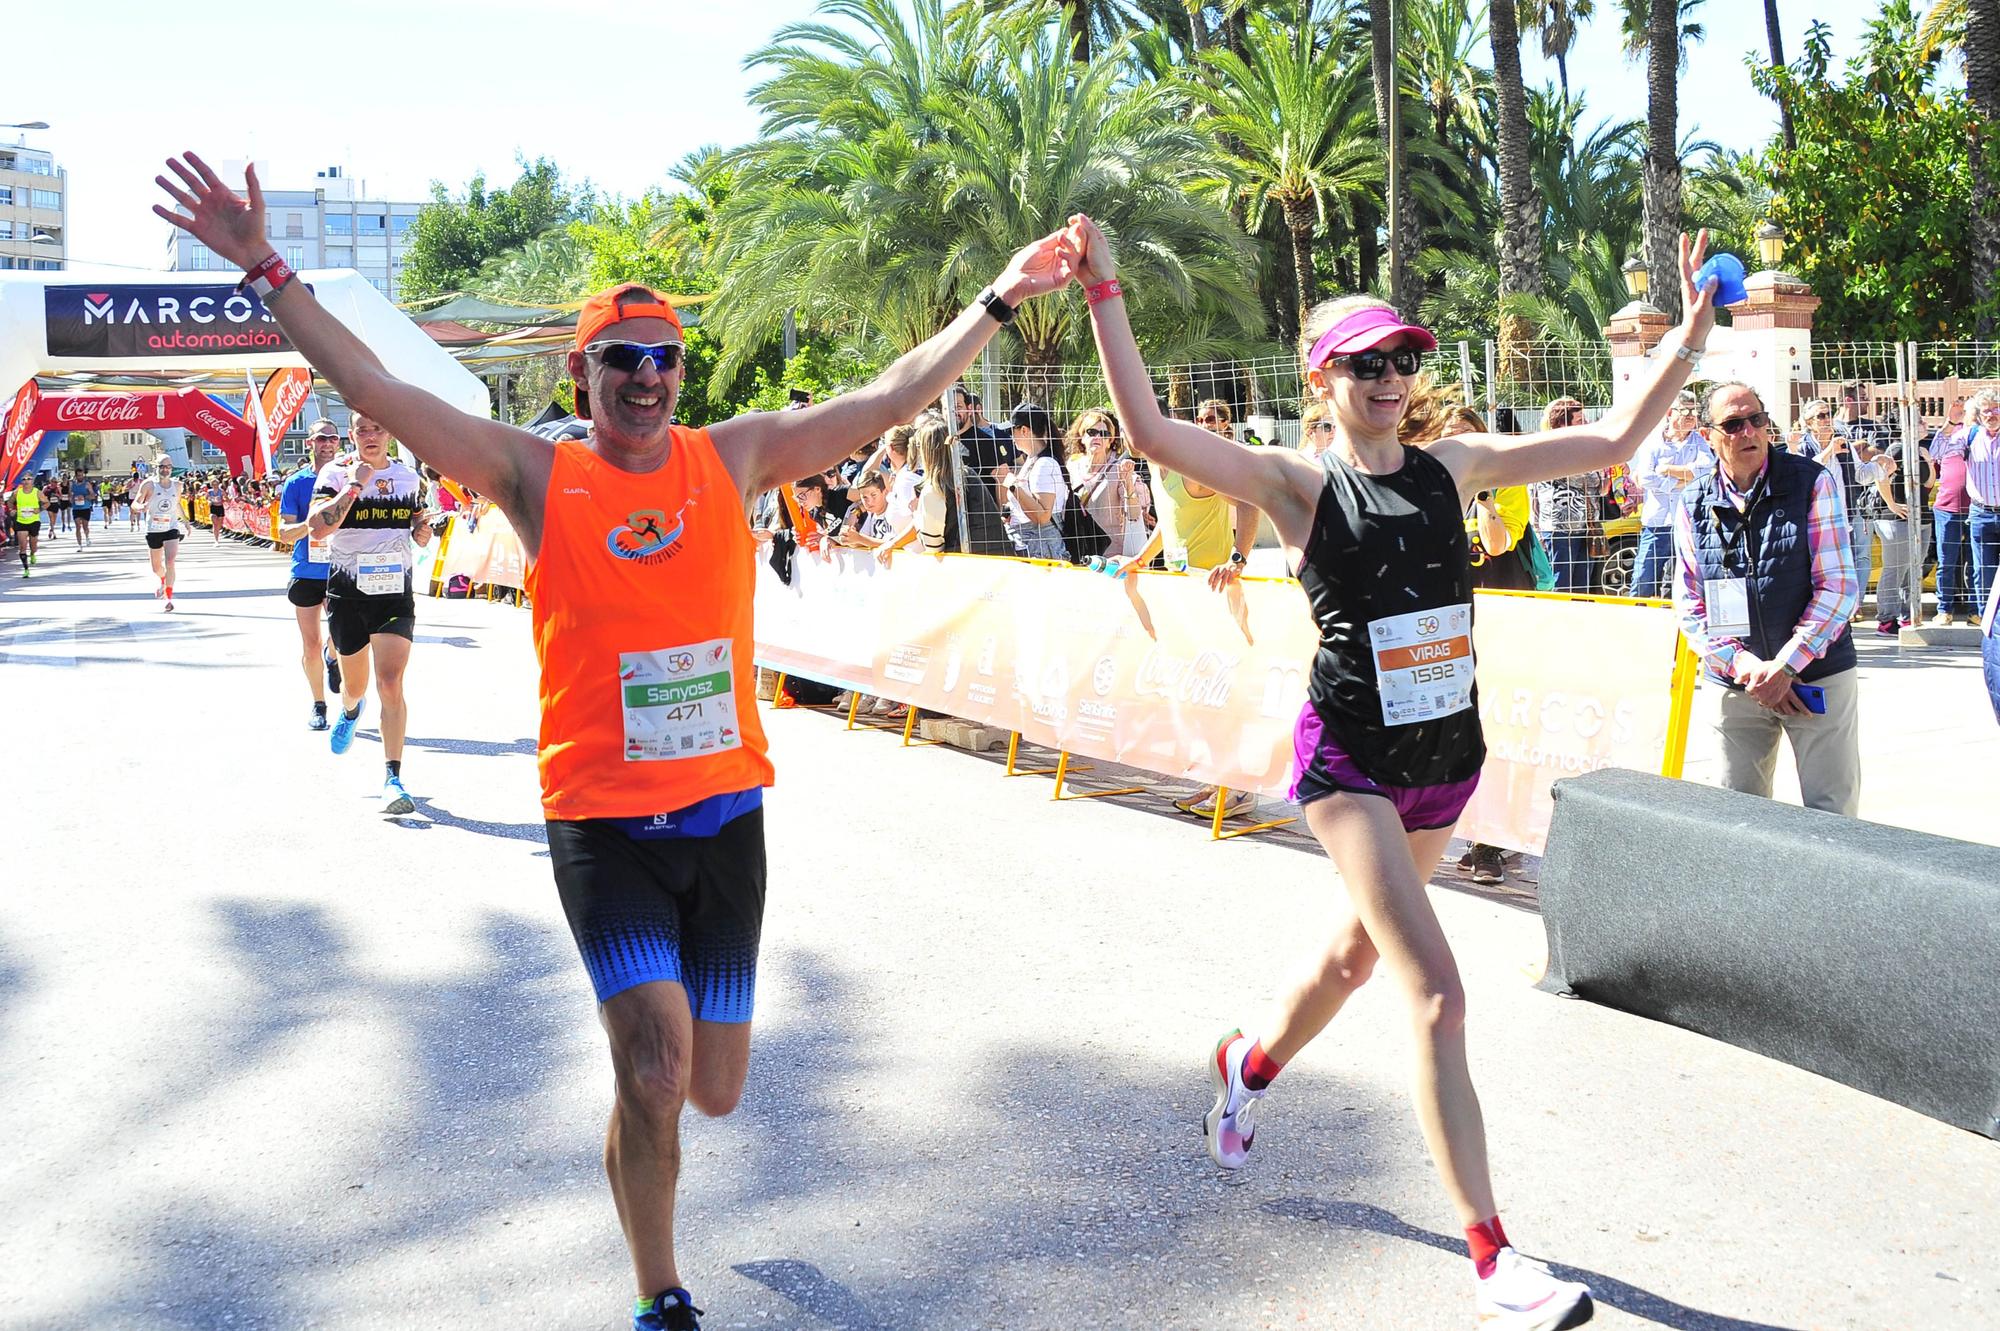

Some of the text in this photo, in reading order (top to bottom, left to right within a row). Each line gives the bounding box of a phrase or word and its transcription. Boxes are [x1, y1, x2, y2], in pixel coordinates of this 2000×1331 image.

[148, 329, 280, 348] automoción
[57, 396, 143, 421] Coca-Cola
[356, 509, 369, 520] NO
[372, 507, 388, 519] PUC
[368, 573, 394, 581] 2029
[1409, 642, 1451, 662] VIRAG
[667, 652, 695, 673] 50
[1410, 663, 1455, 684] 1592
[647, 681, 713, 702] Sanyosz
[667, 703, 703, 721] 471
